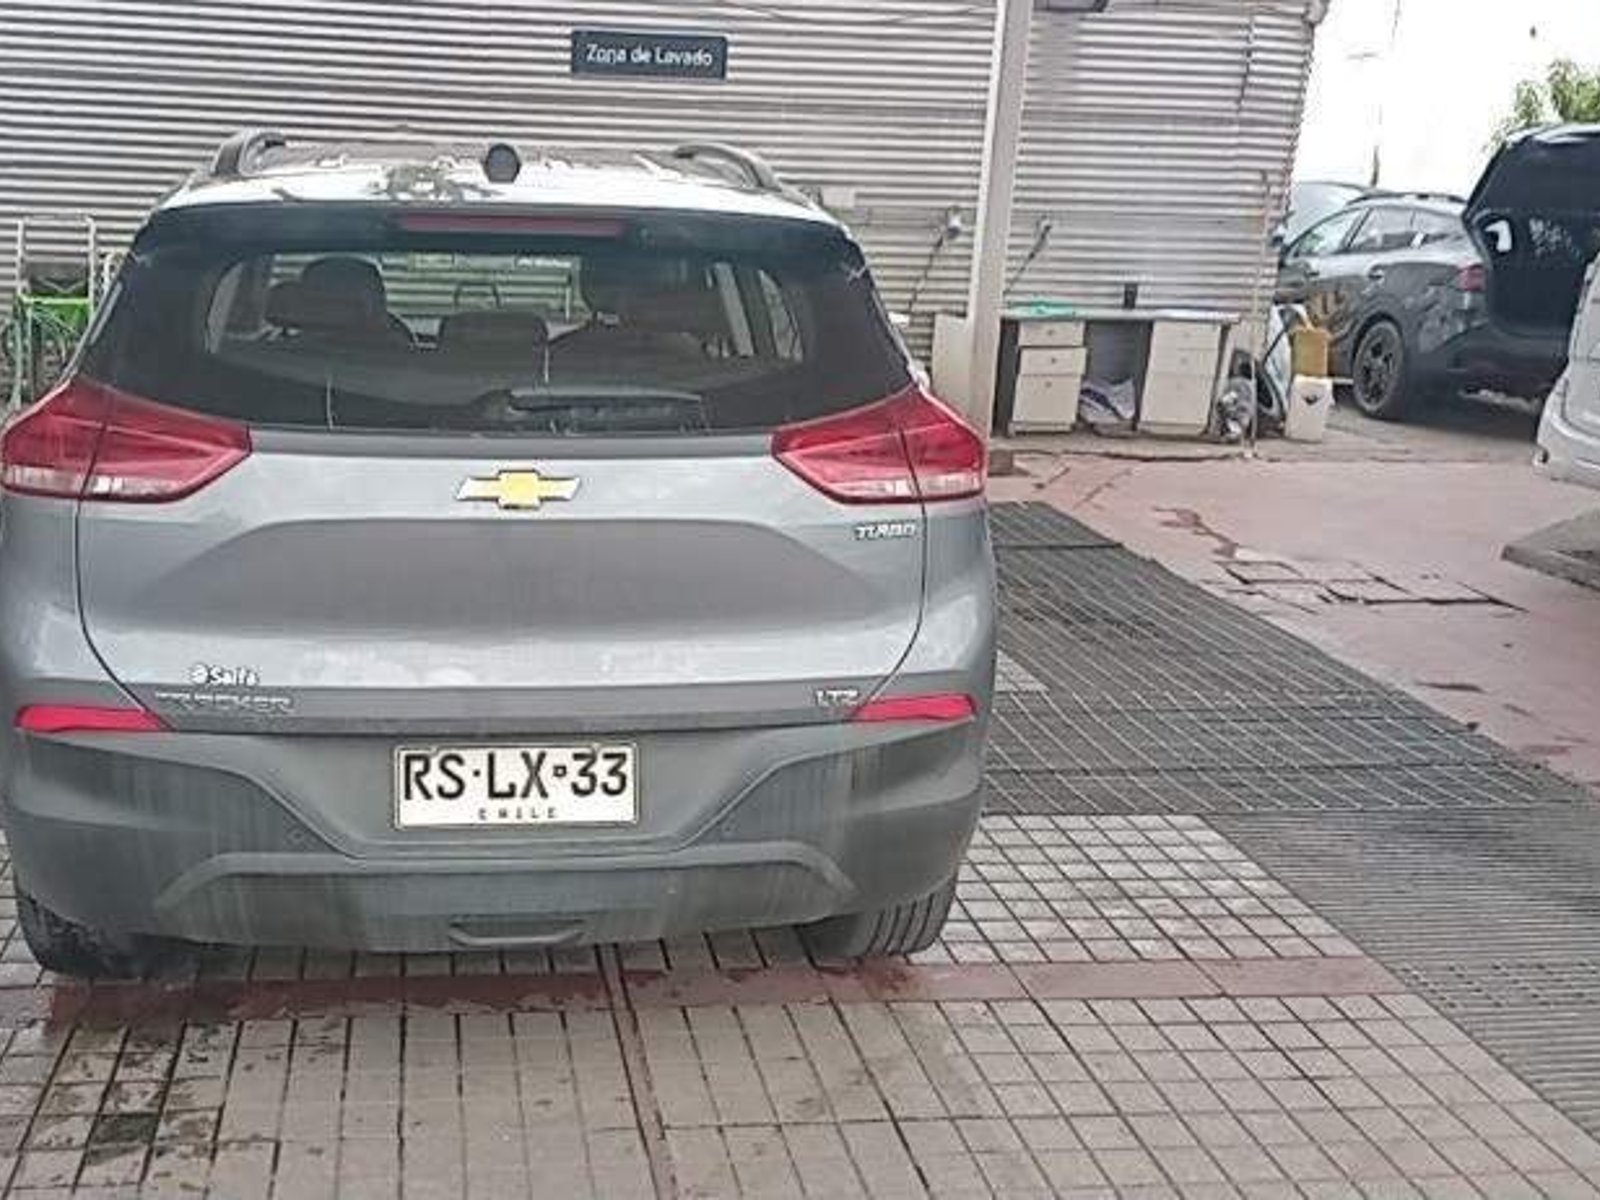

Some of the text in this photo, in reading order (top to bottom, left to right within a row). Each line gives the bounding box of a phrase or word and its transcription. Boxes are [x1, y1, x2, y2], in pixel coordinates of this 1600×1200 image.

[586, 43, 713, 66] Zona de Lavado
